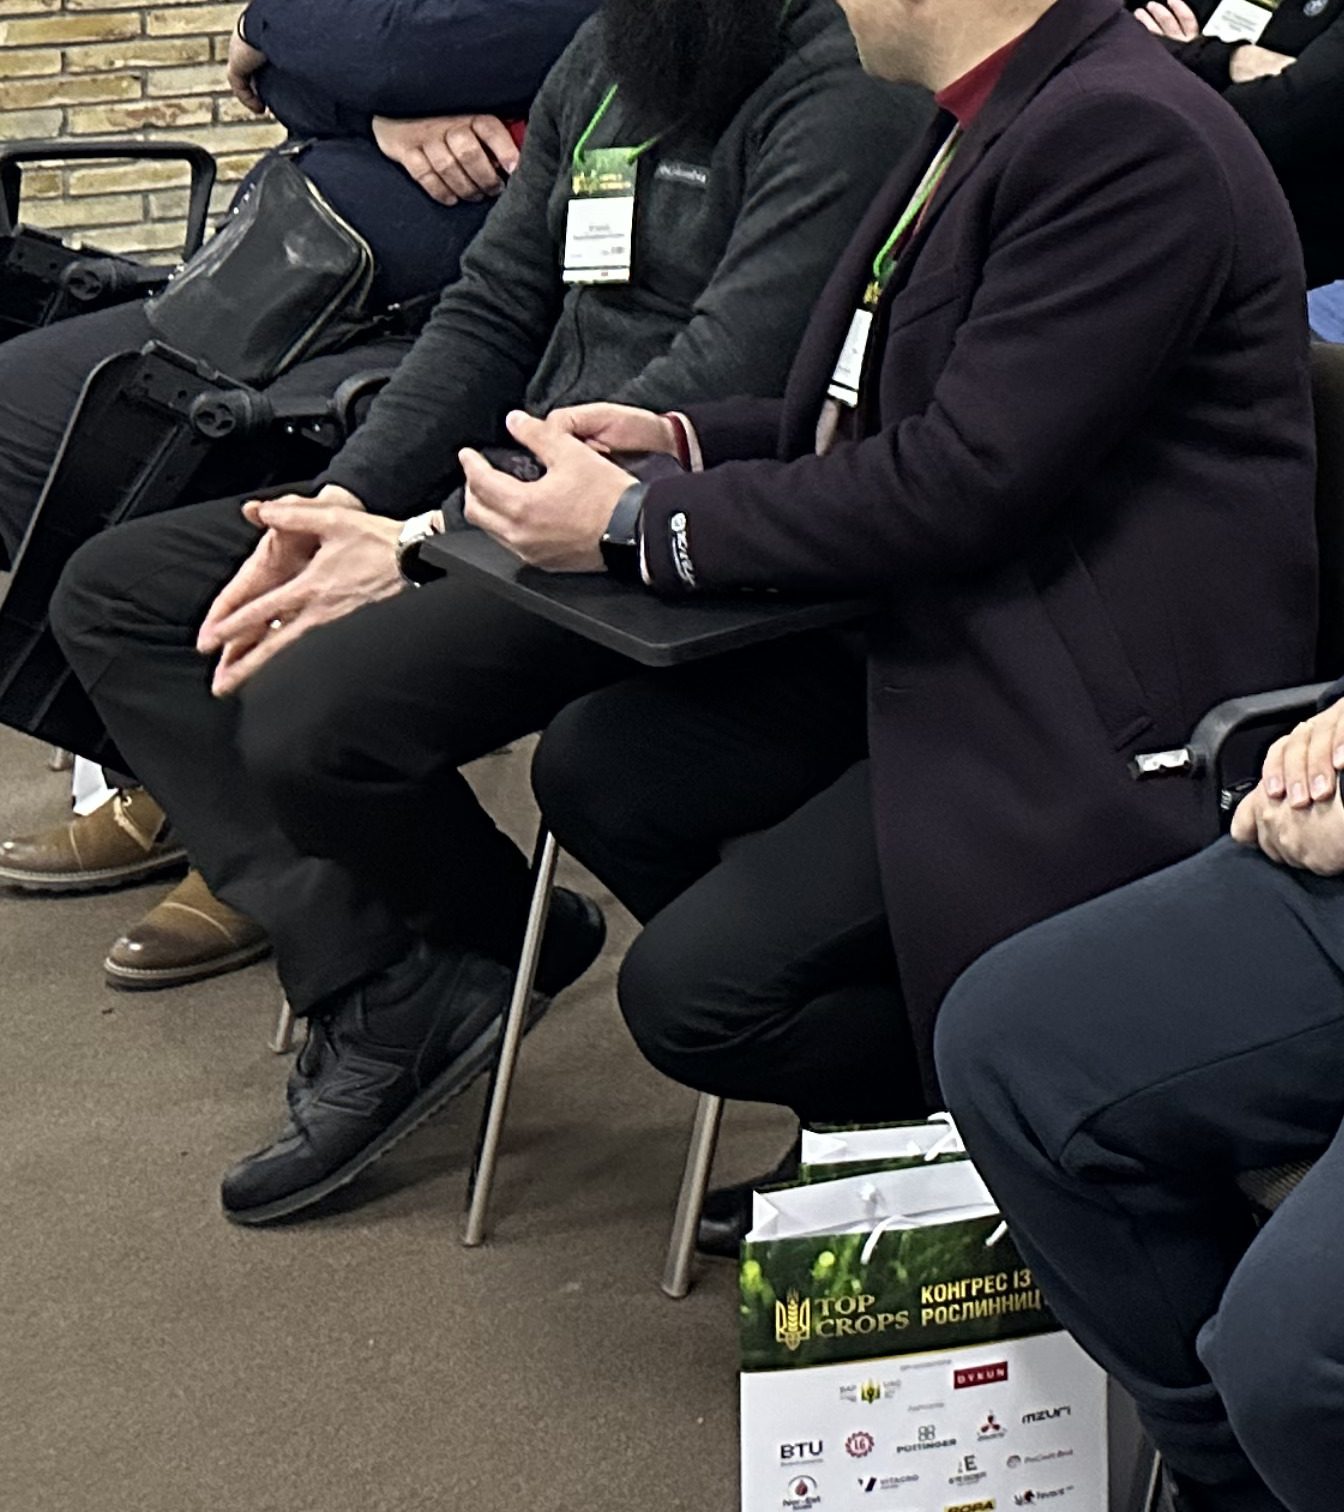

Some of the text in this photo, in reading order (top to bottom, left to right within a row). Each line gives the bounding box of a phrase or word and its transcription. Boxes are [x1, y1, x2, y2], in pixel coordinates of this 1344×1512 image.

[921, 1268, 1032, 1305] КОНГРЕС ІЗ
[816, 1294, 876, 1316] TOP
[815, 1310, 910, 1338] CROPS
[780, 1439, 823, 1460] BTU
